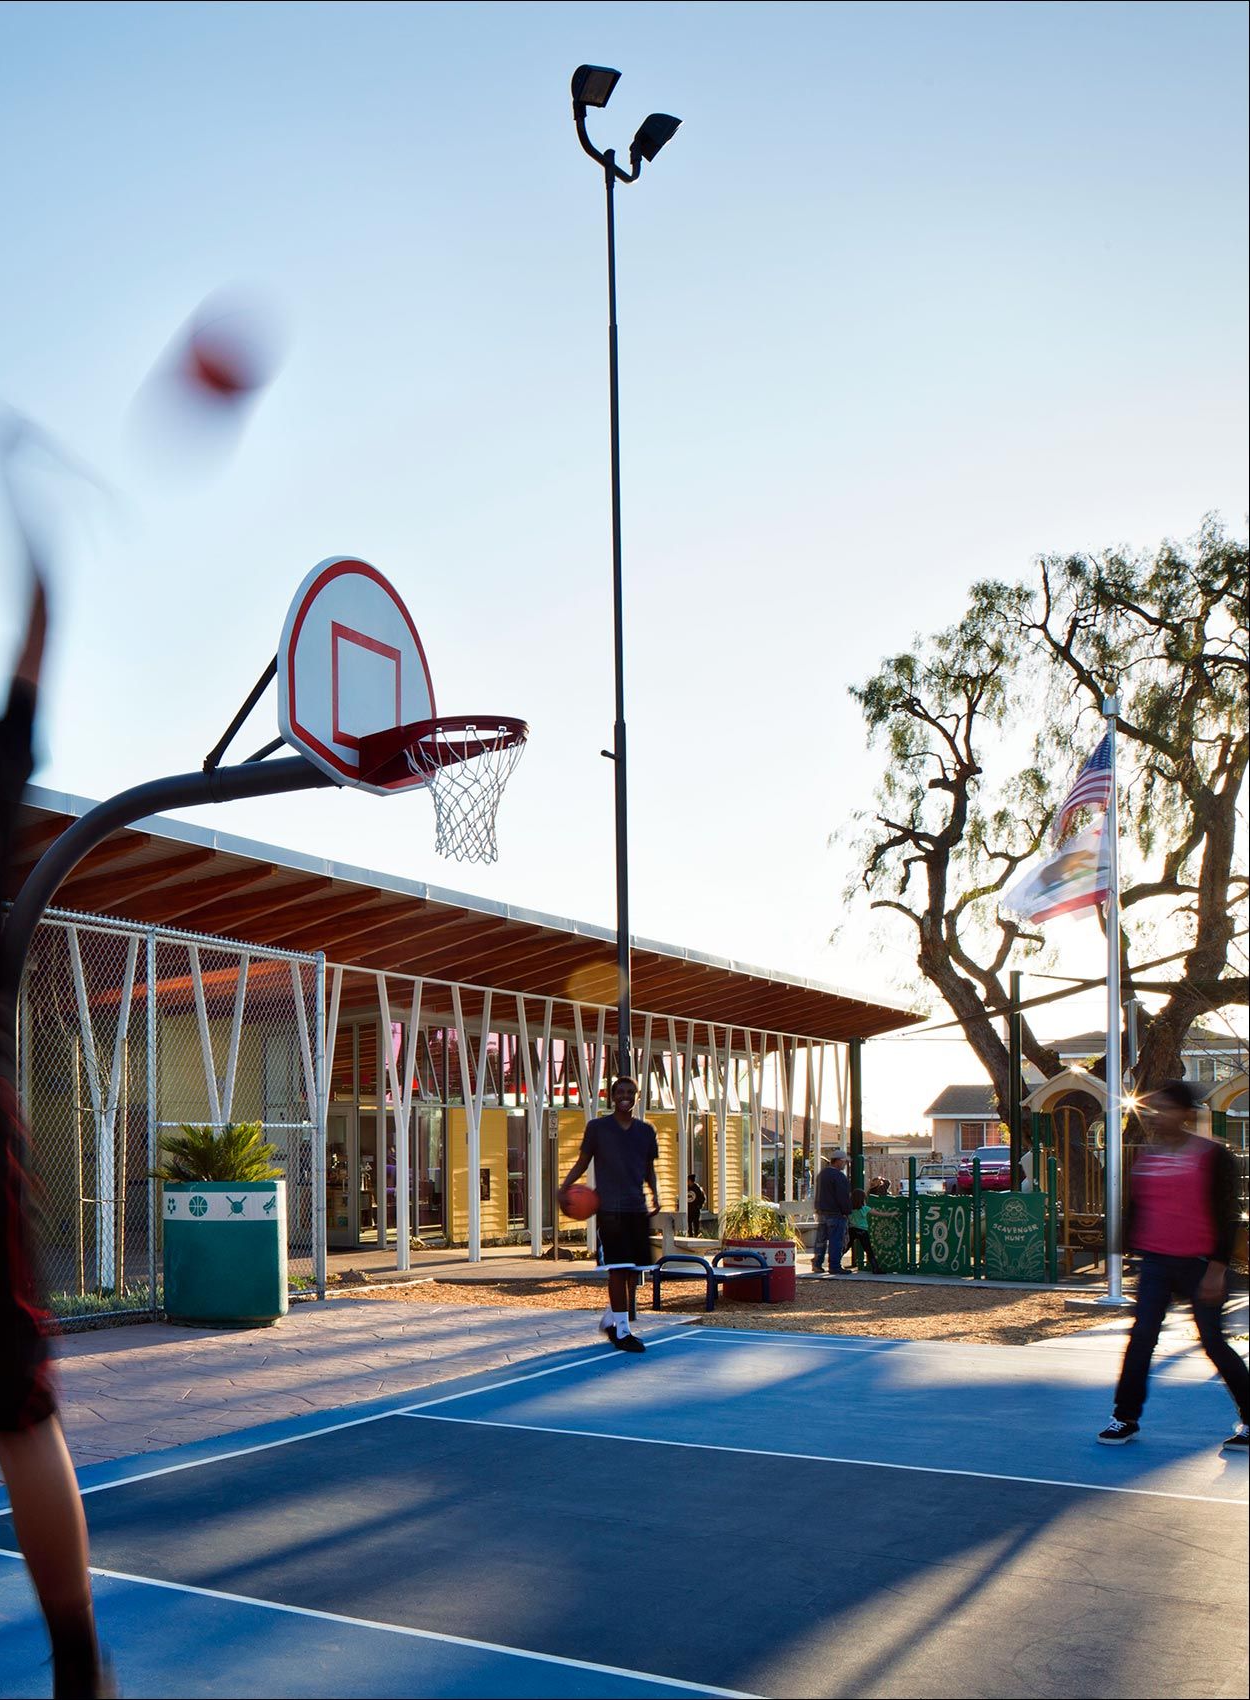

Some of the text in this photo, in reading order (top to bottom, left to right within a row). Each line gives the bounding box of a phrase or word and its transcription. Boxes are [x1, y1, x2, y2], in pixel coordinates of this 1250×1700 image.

[925, 1206, 941, 1220] 5
[922, 1223, 930, 1236] 3
[992, 1223, 1039, 1233] SCAVENGER
